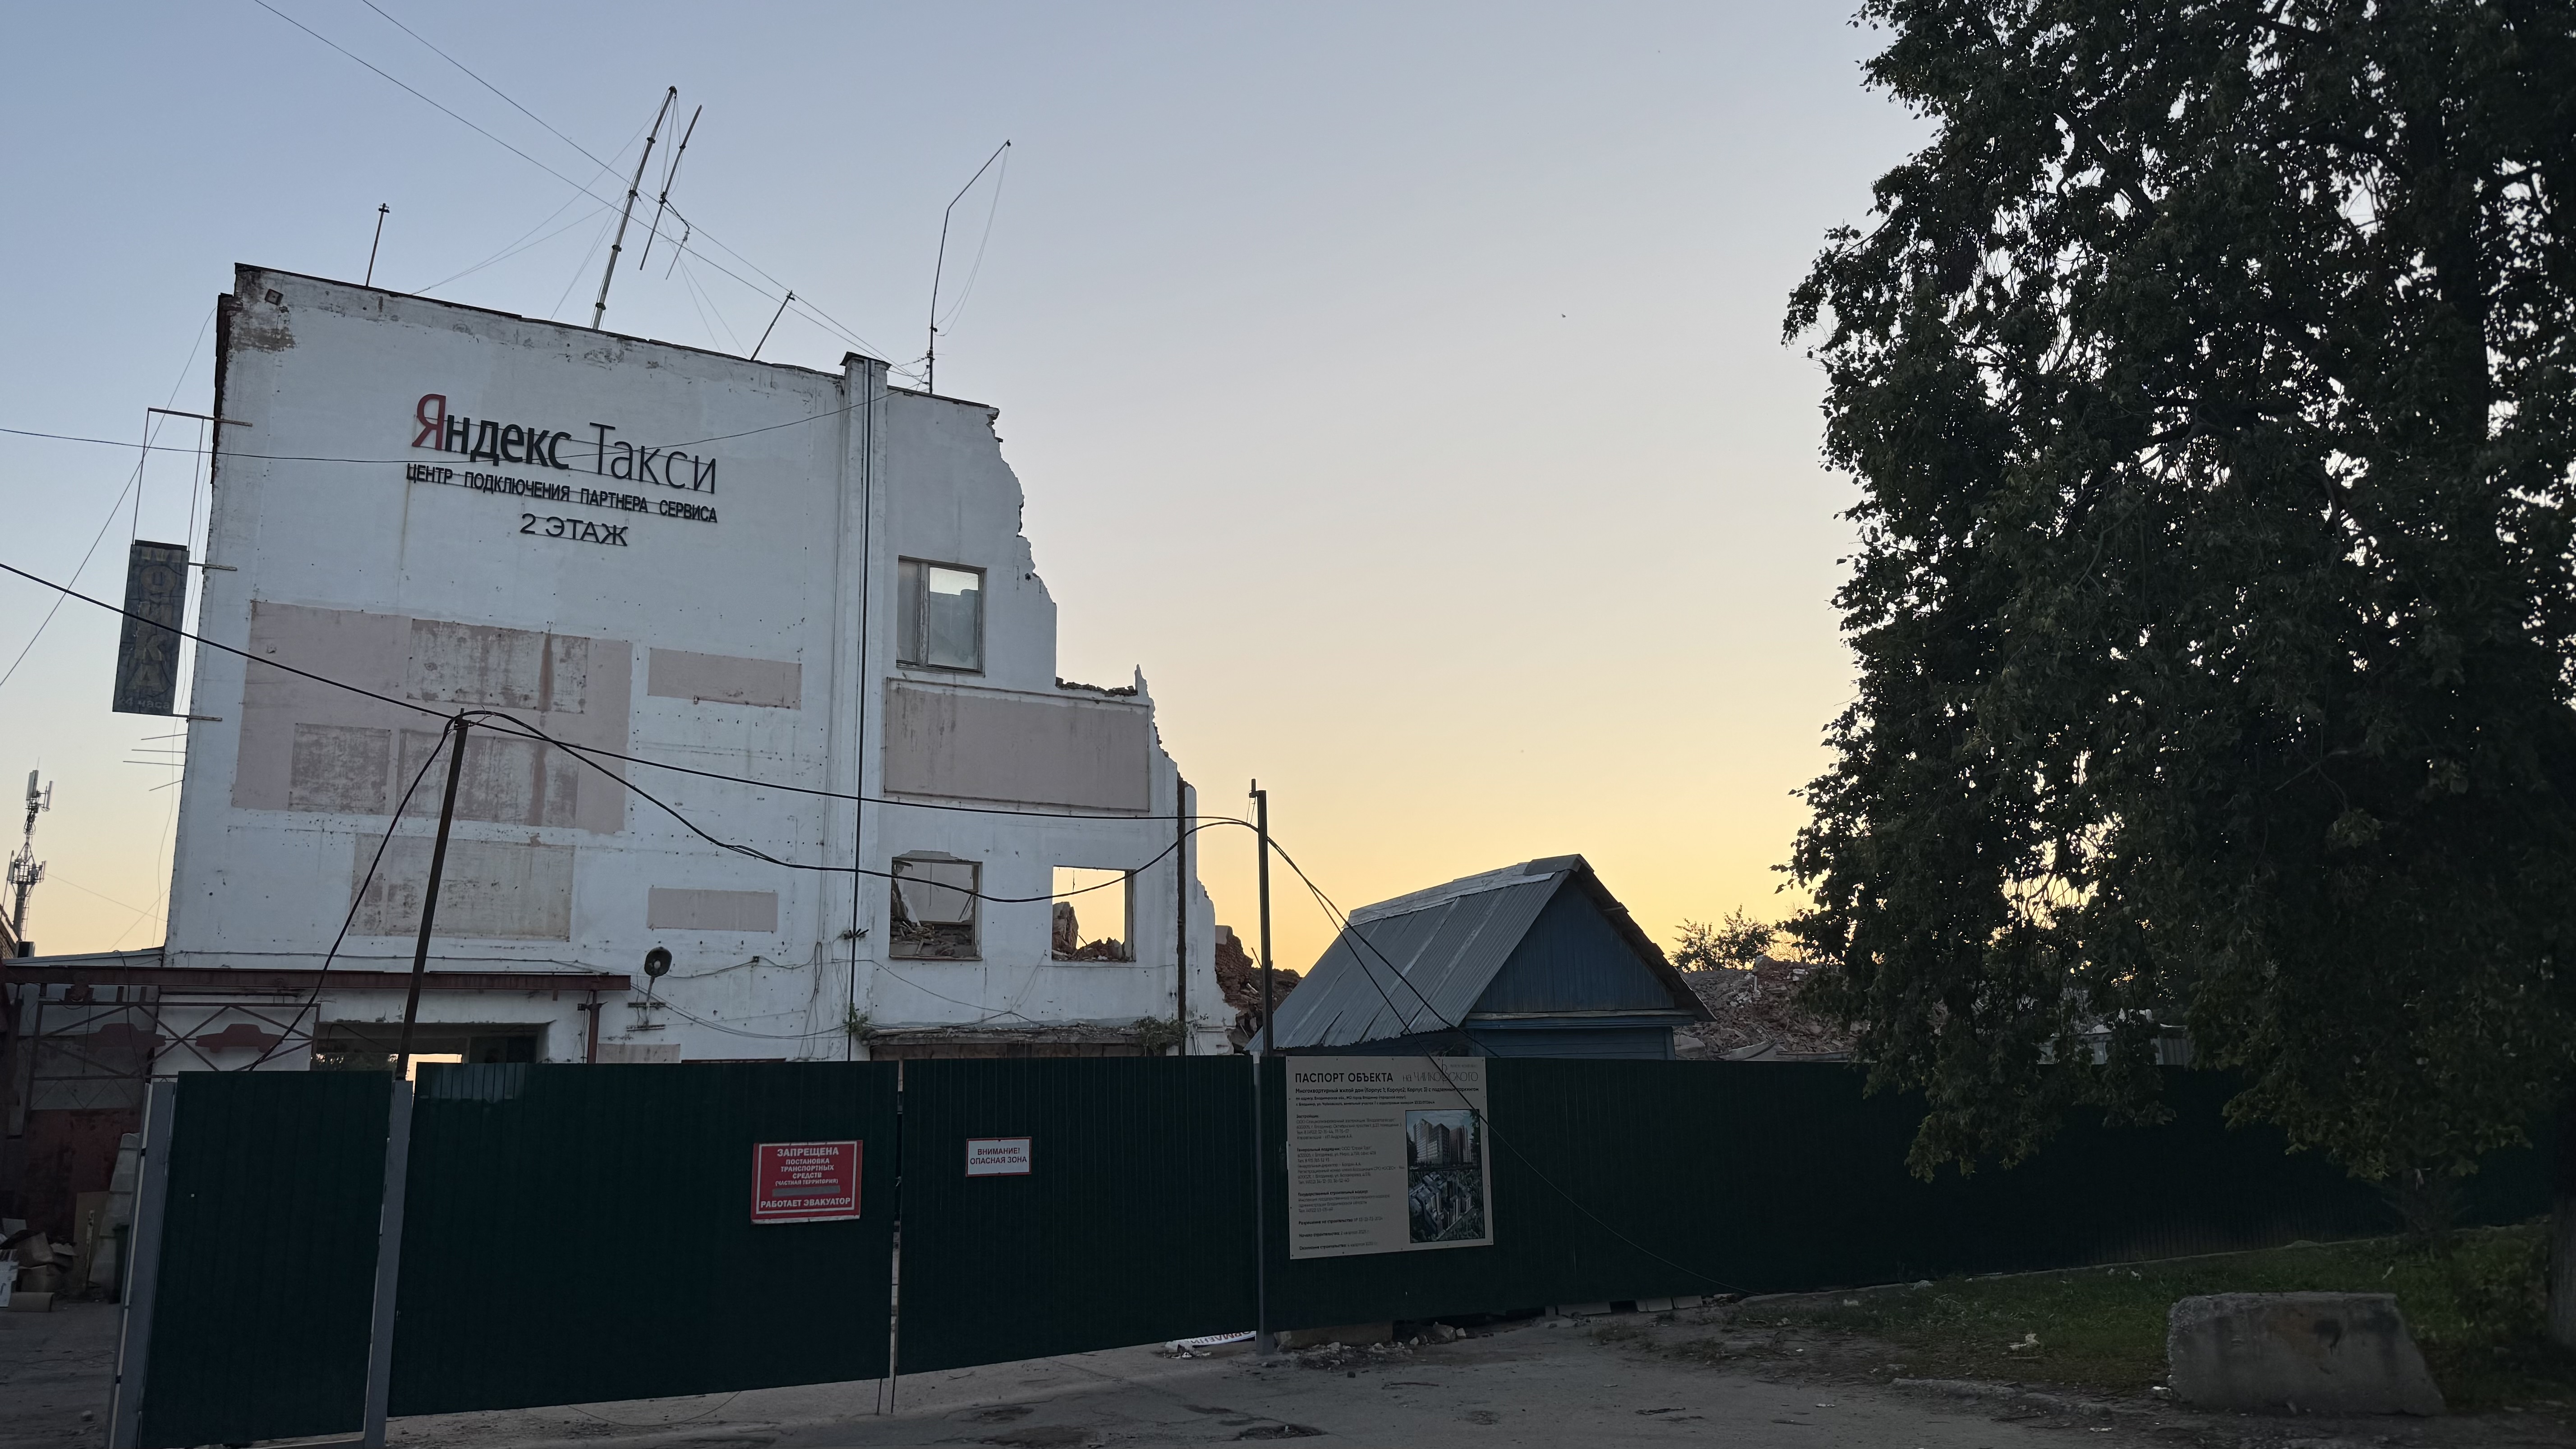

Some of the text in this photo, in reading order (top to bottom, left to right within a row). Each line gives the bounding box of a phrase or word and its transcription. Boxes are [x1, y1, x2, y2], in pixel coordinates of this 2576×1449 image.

[412, 393, 716, 494] Яндекс Такси
[406, 463, 718, 523] ЦЕНТР ПОДКЛЮЧЕНИЯ ПАРТНЕРА СЕРВИСА
[520, 513, 628, 546] 2 ЭТАЖ
[138, 699, 171, 709] часа
[1295, 1072, 1394, 1083] ПАСПОРТ ОБЪЕКТА
[1403, 1074, 1412, 1082] на
[777, 1147, 839, 1157] ЗАПРЕЩЕНА
[760, 1197, 851, 1208] РАБОТАЕТ ЭВАКУАТОР
